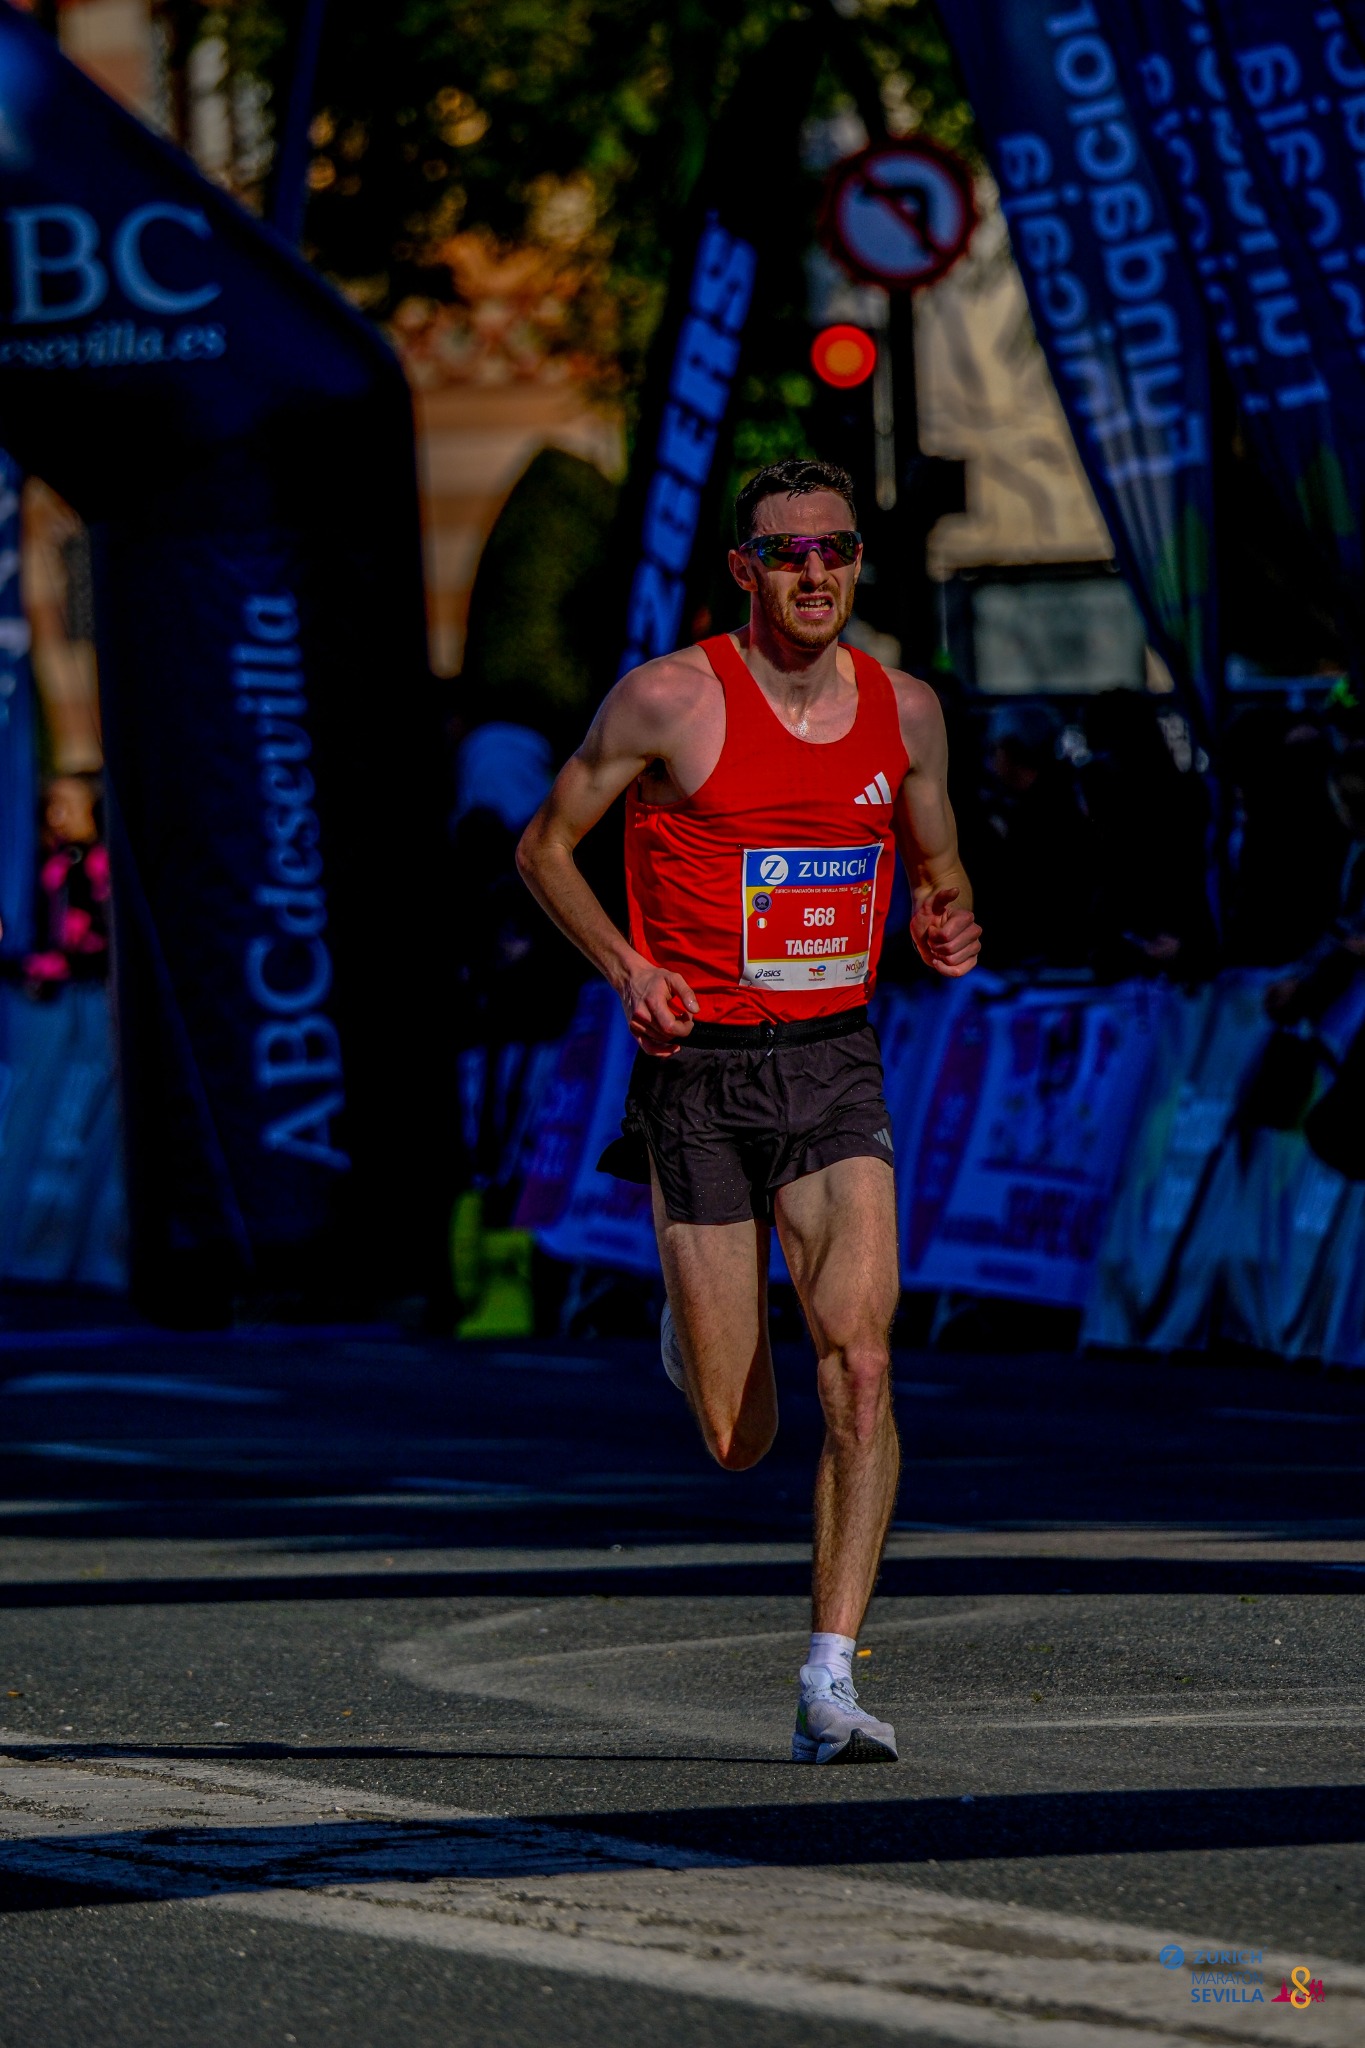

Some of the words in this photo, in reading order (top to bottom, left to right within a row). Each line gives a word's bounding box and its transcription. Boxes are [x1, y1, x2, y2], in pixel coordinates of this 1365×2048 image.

[798, 858, 867, 877] ZURICH
[228, 589, 353, 1181] ABCdesevilla
[803, 907, 836, 927] 568
[785, 937, 849, 956] TAGGART
[763, 968, 781, 977] asics
